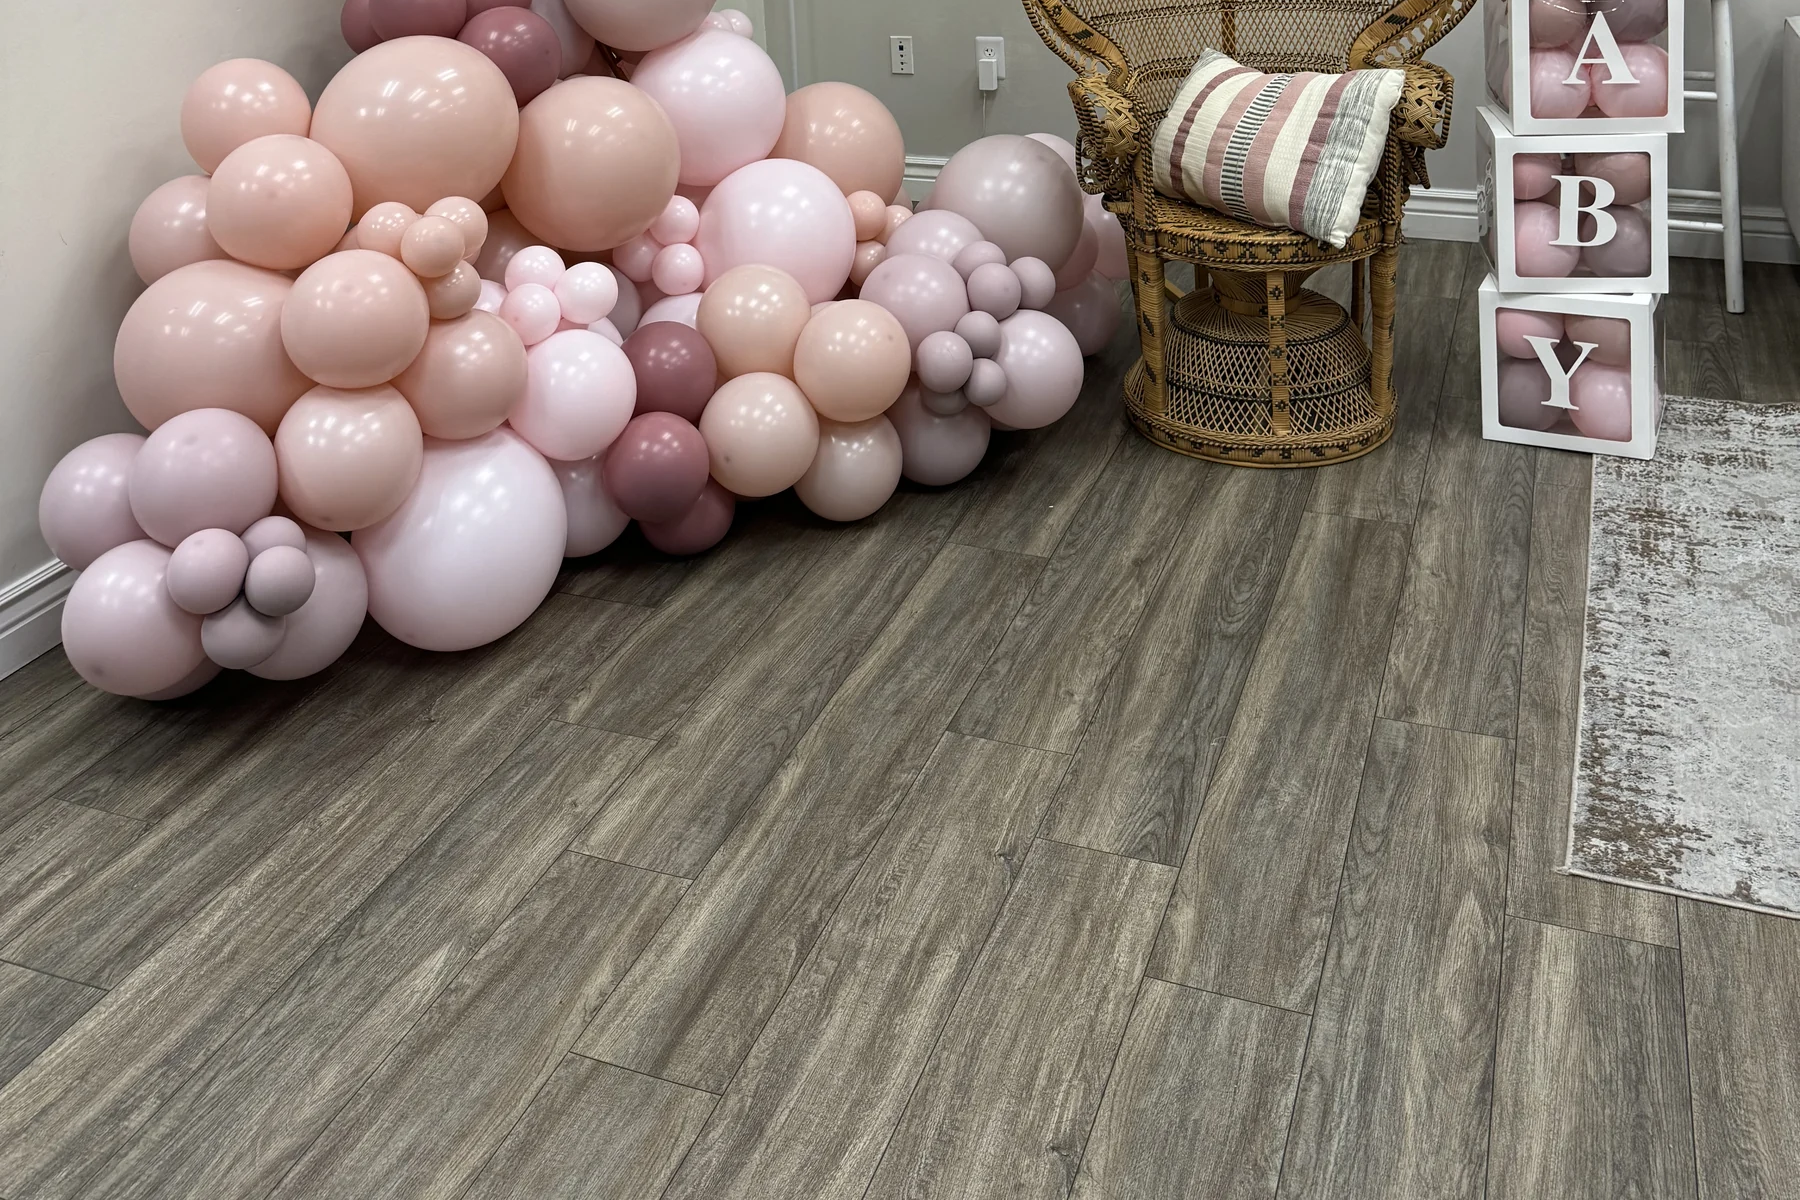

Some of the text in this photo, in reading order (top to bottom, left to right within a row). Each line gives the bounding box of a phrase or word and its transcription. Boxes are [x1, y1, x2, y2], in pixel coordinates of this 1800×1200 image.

[1562, 11, 1640, 85] A
[1550, 175, 1617, 246] B
[1523, 335, 1598, 410] Y
